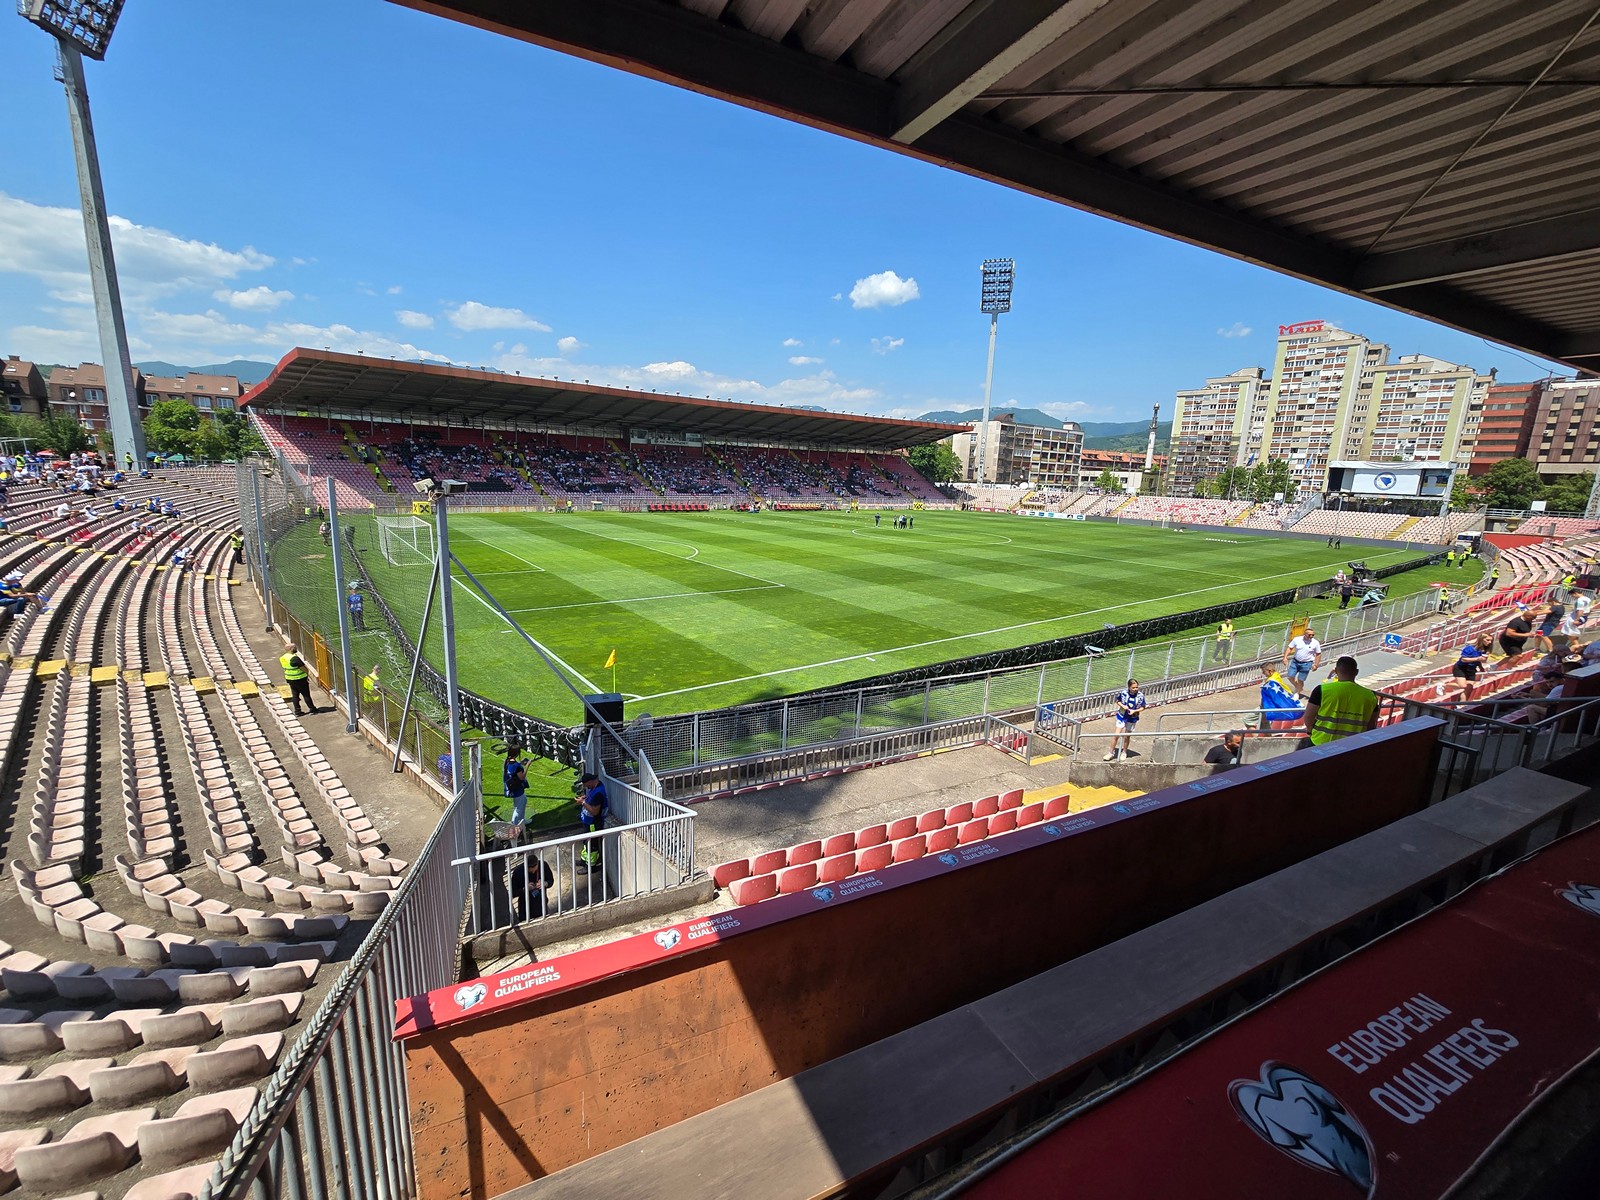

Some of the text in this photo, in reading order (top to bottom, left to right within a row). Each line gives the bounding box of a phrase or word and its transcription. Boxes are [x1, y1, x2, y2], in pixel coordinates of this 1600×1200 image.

[839, 876, 875, 889] EUROPEAN
[840, 880, 883, 896] QUALIFIERS
[688, 919, 741, 939] QUALIFIERS
[689, 915, 733, 932] EUROPEAN
[494, 972, 561, 998] QUALIFIERS
[499, 966, 554, 987] EUROPEAN
[1327, 993, 1452, 1074] EUROPEAN
[1369, 1018, 1519, 1125] QUALIFIERS
